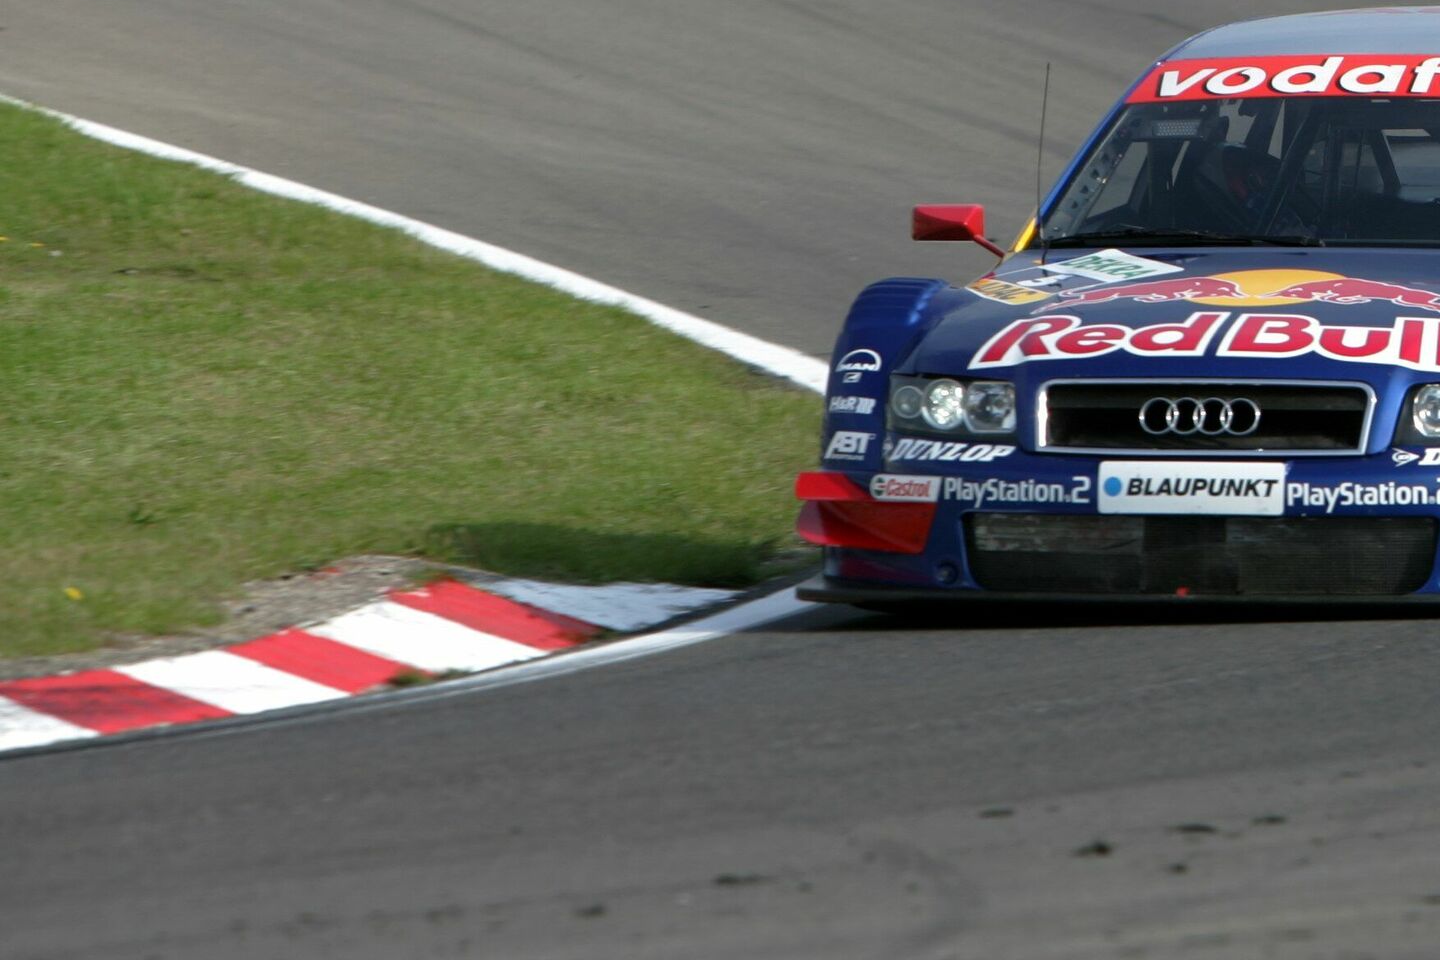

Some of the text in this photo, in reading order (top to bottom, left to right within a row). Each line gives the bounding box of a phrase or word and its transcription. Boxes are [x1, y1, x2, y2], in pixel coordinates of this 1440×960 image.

[1060, 255, 1158, 279] DEKRA
[974, 312, 1224, 366] Red
[890, 438, 1017, 462] DUNLOP
[884, 479, 931, 498] Castrol
[1126, 478, 1279, 497] BLAUPUNKT
